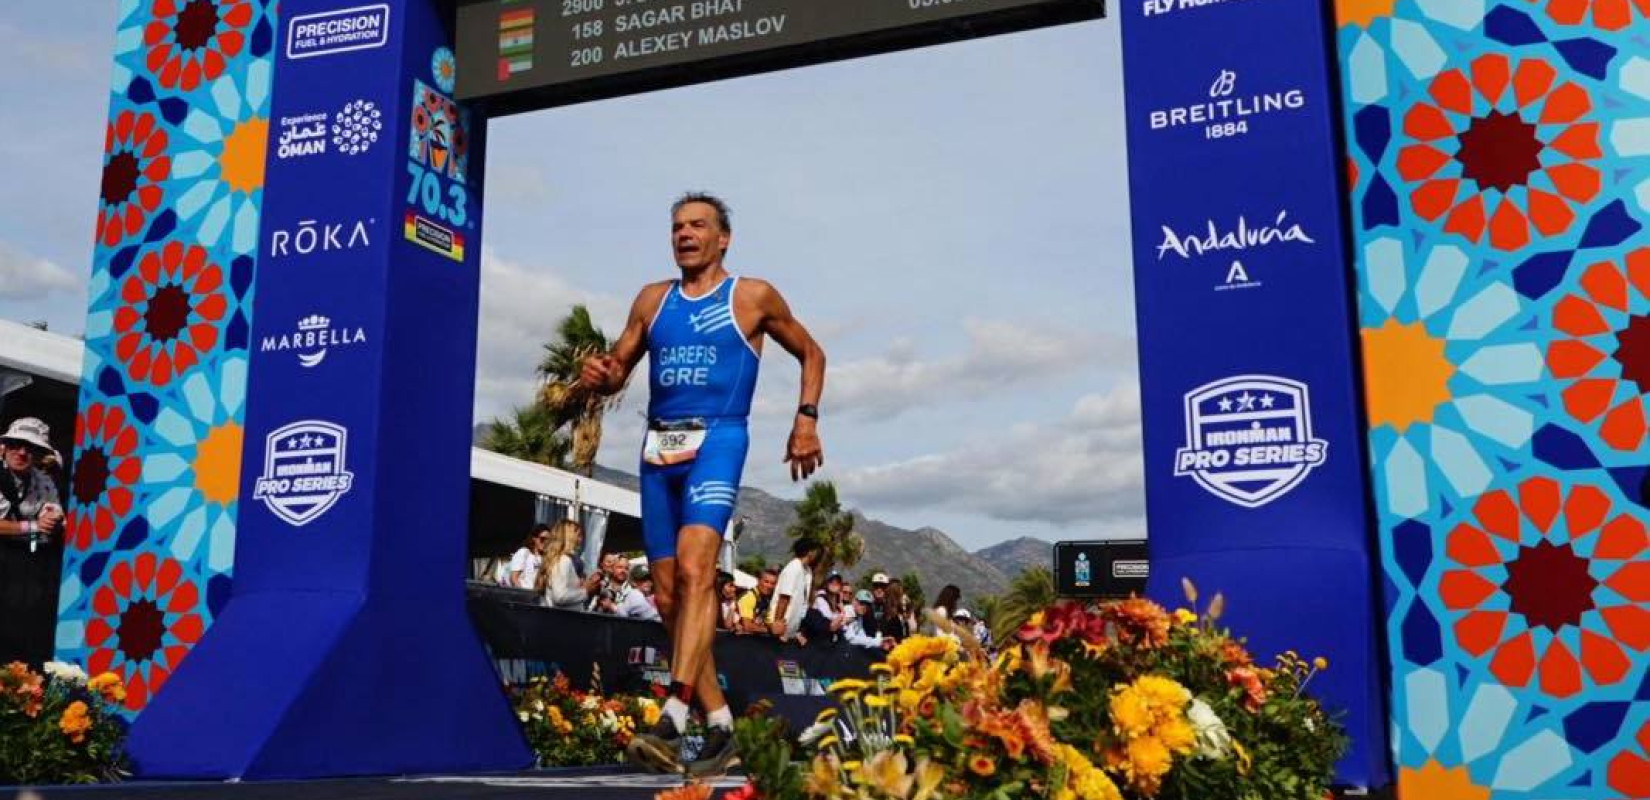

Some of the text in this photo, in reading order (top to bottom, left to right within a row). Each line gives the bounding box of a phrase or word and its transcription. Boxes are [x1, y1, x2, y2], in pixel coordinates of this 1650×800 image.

[1143, 0, 1173, 16] FLY
[296, 14, 380, 38] PRECISION
[571, 19, 604, 39] 158
[615, 5, 686, 32] SAGAR
[295, 39, 318, 49] FUEL
[327, 29, 379, 43] HYDRATION
[571, 14, 785, 67] 200 ALEXEY MASLOV
[281, 112, 327, 126] Experience
[1151, 90, 1304, 129] BREITLING
[1206, 120, 1248, 139] 1884
[278, 139, 325, 158] OMAN
[407, 161, 467, 227] 70.3
[1156, 209, 1315, 261] Andalucía
[261, 327, 366, 352] MARBELLA
[660, 345, 717, 366] GAREFIS
[660, 367, 709, 386] GRE
[1206, 421, 1292, 447] IRONMAN
[1179, 443, 1321, 471] PRO SERIES
[257, 475, 348, 495] PRO SERIES
